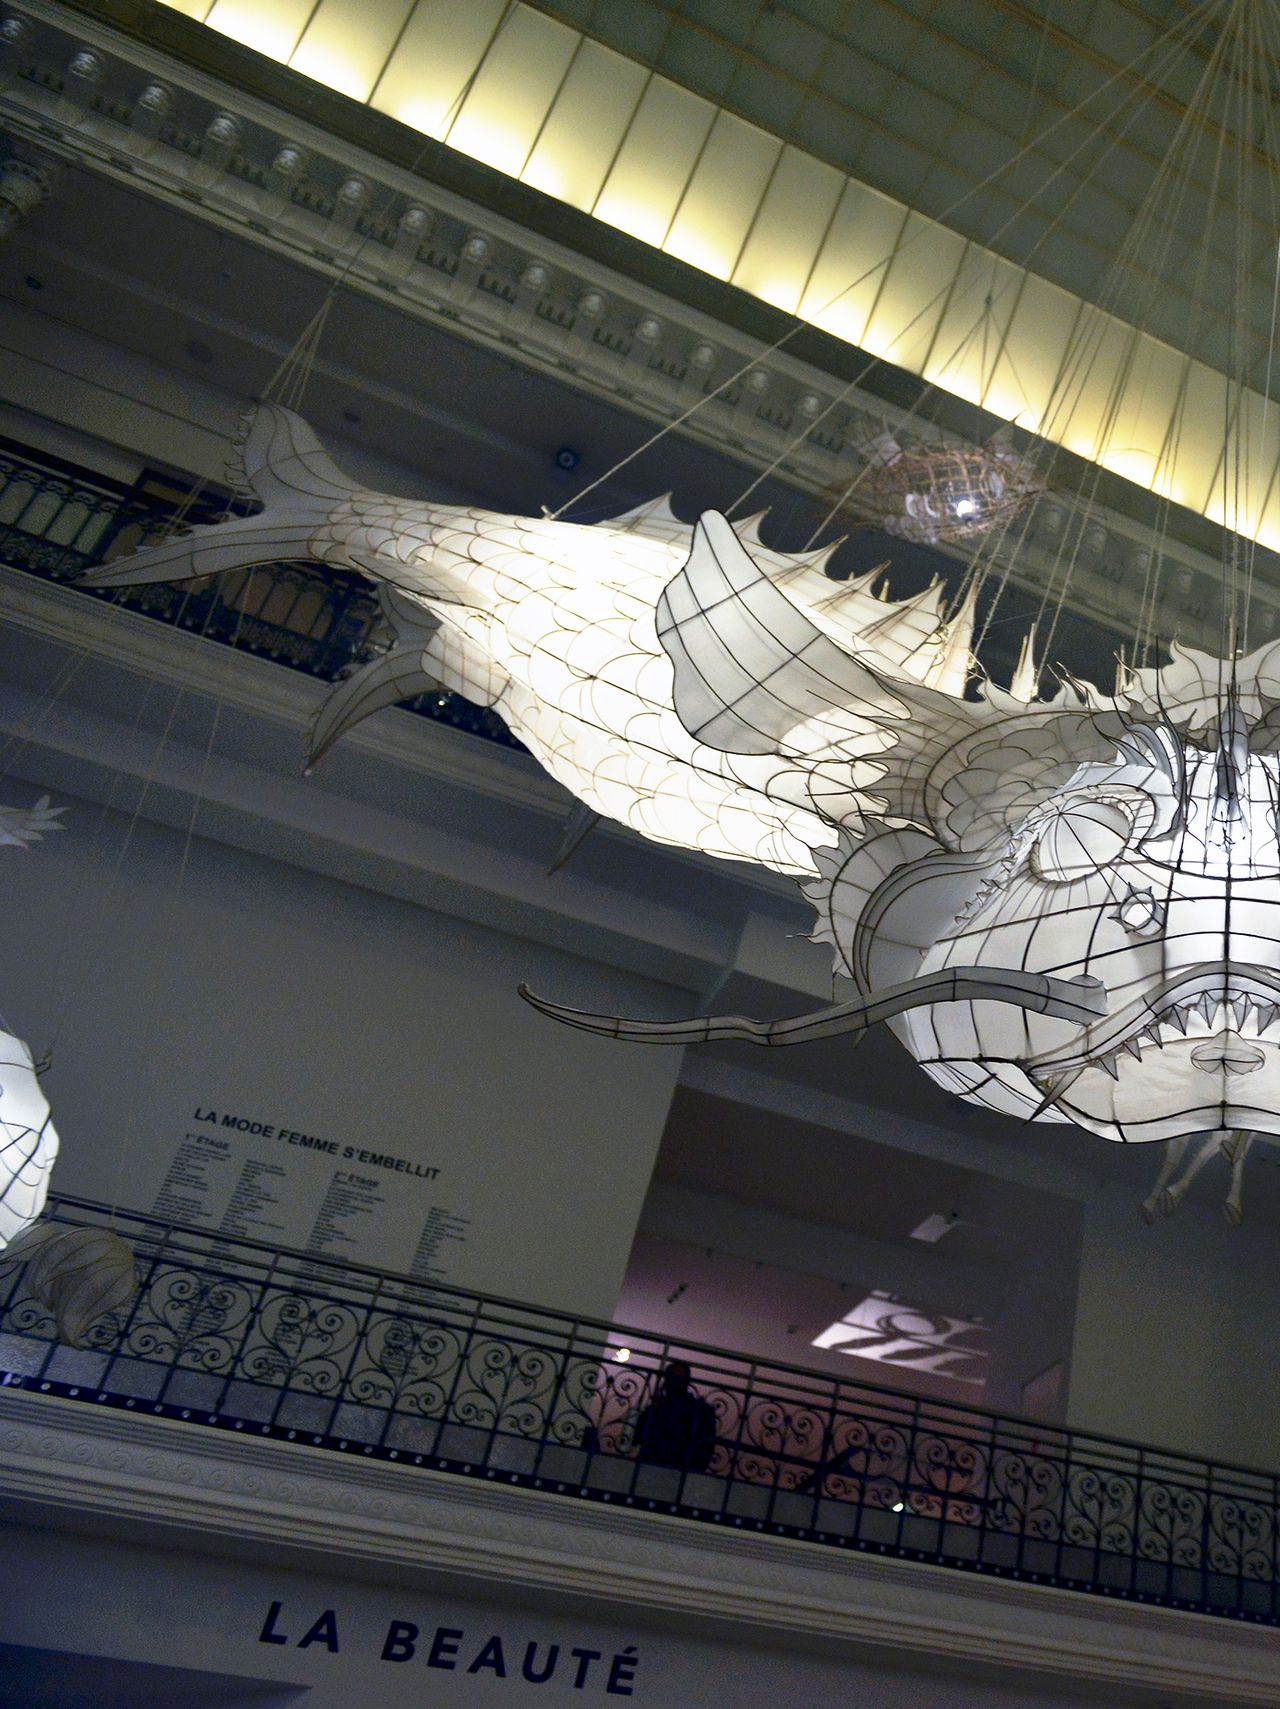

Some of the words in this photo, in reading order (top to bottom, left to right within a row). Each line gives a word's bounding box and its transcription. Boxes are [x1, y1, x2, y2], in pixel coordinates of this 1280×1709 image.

[193, 1107, 217, 1125] LA
[221, 1115, 276, 1139] MODE
[277, 1128, 340, 1156] FEMME
[343, 1145, 440, 1180] S'EMBELLIT
[258, 1601, 340, 1654] LA
[380, 1620, 640, 1697] BEAUTÉ
